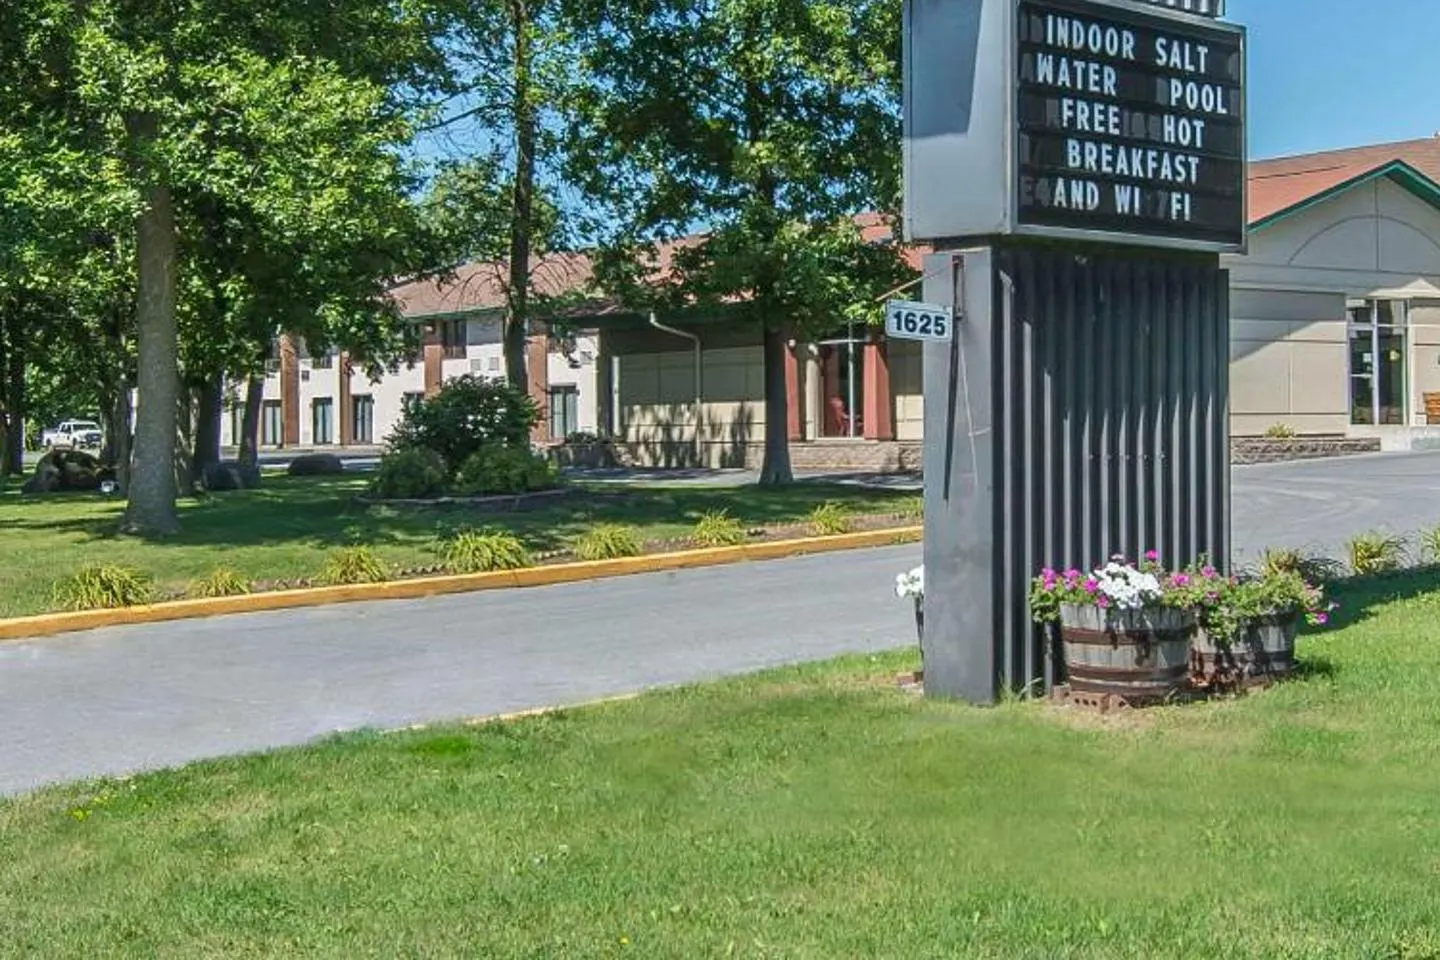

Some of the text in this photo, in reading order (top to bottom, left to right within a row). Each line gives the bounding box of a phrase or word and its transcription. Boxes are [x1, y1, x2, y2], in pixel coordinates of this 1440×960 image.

[1046, 14, 1208, 73] INDOOR SALT
[1037, 53, 1228, 114] WATER POOL
[1062, 98, 1205, 148] FREE HOT
[1067, 139, 1199, 184] BREAKFAST
[1053, 177, 1191, 221] AND WI FI
[893, 310, 946, 336] 1625
